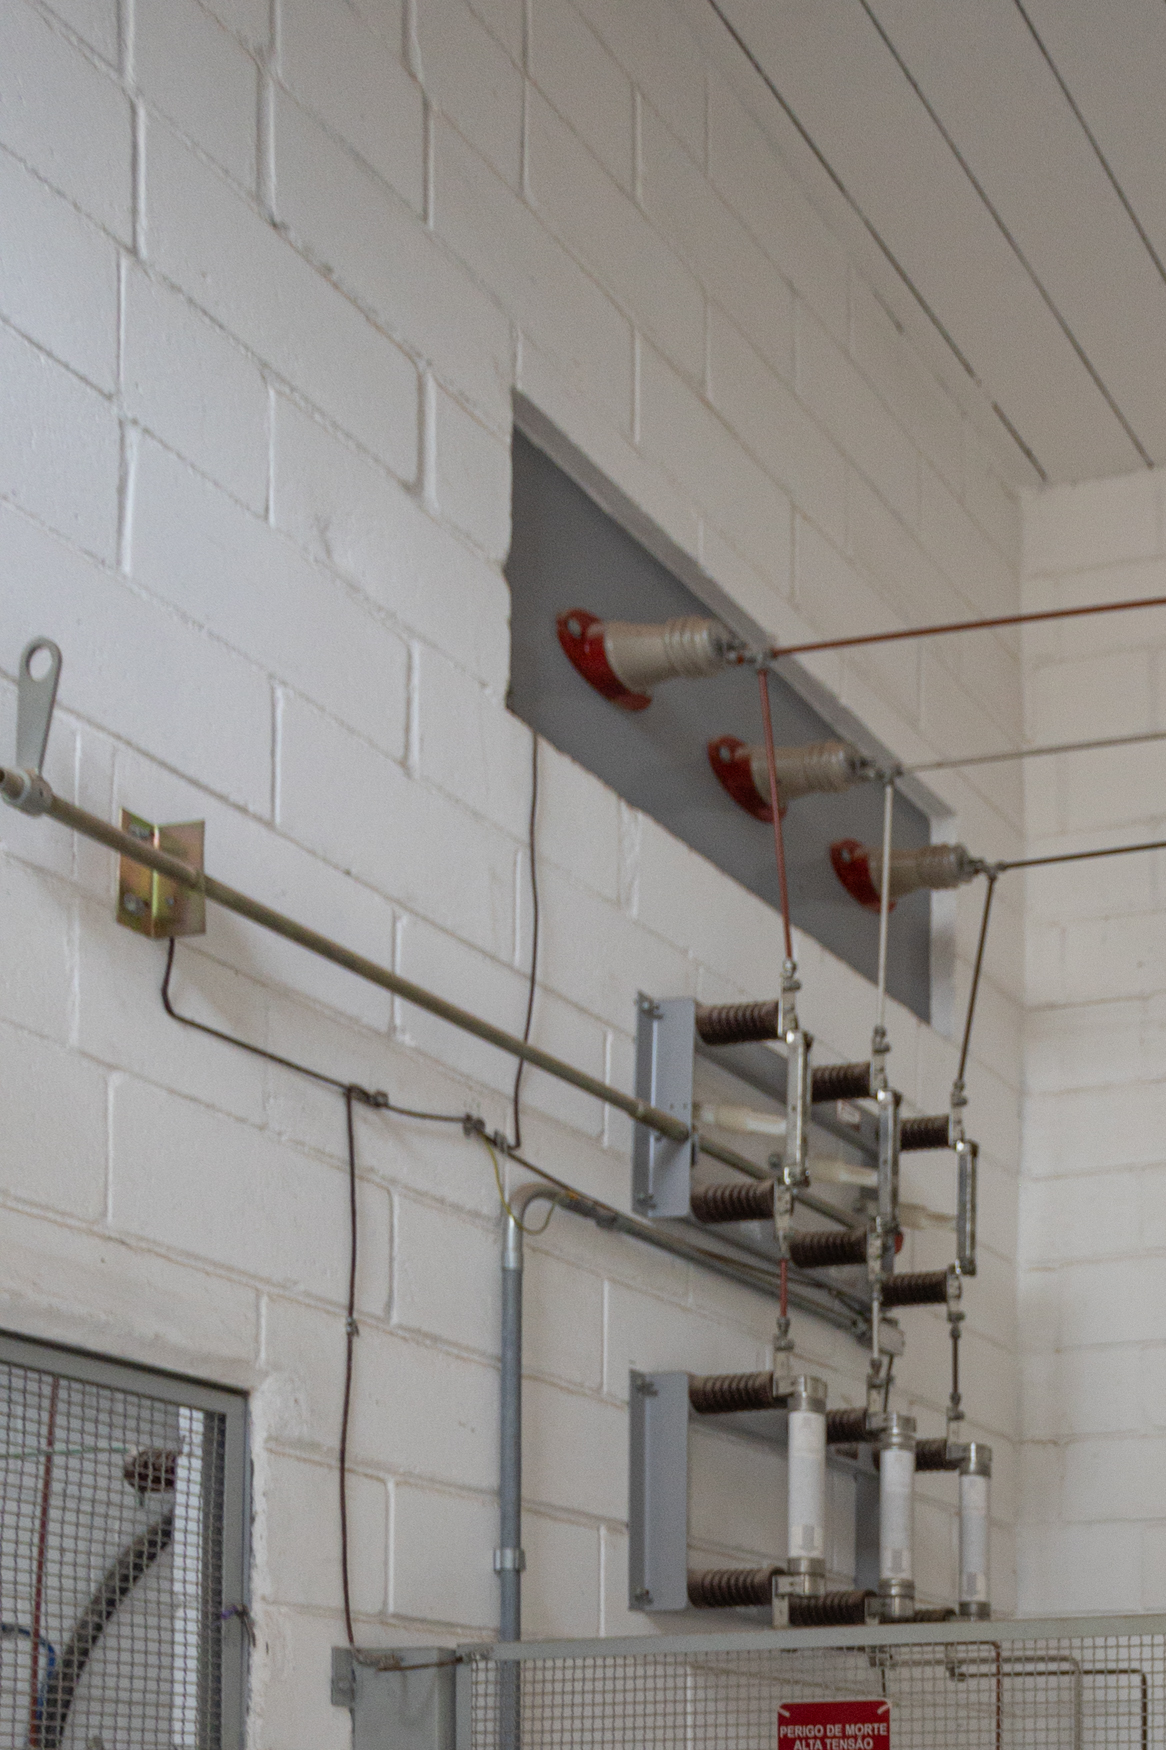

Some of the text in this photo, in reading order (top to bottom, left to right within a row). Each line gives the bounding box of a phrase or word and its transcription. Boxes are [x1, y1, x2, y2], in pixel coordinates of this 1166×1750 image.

[780, 1723, 888, 1739] PERIGO DE MORTE
[824, 1735, 874, 1750] TENSÃO
